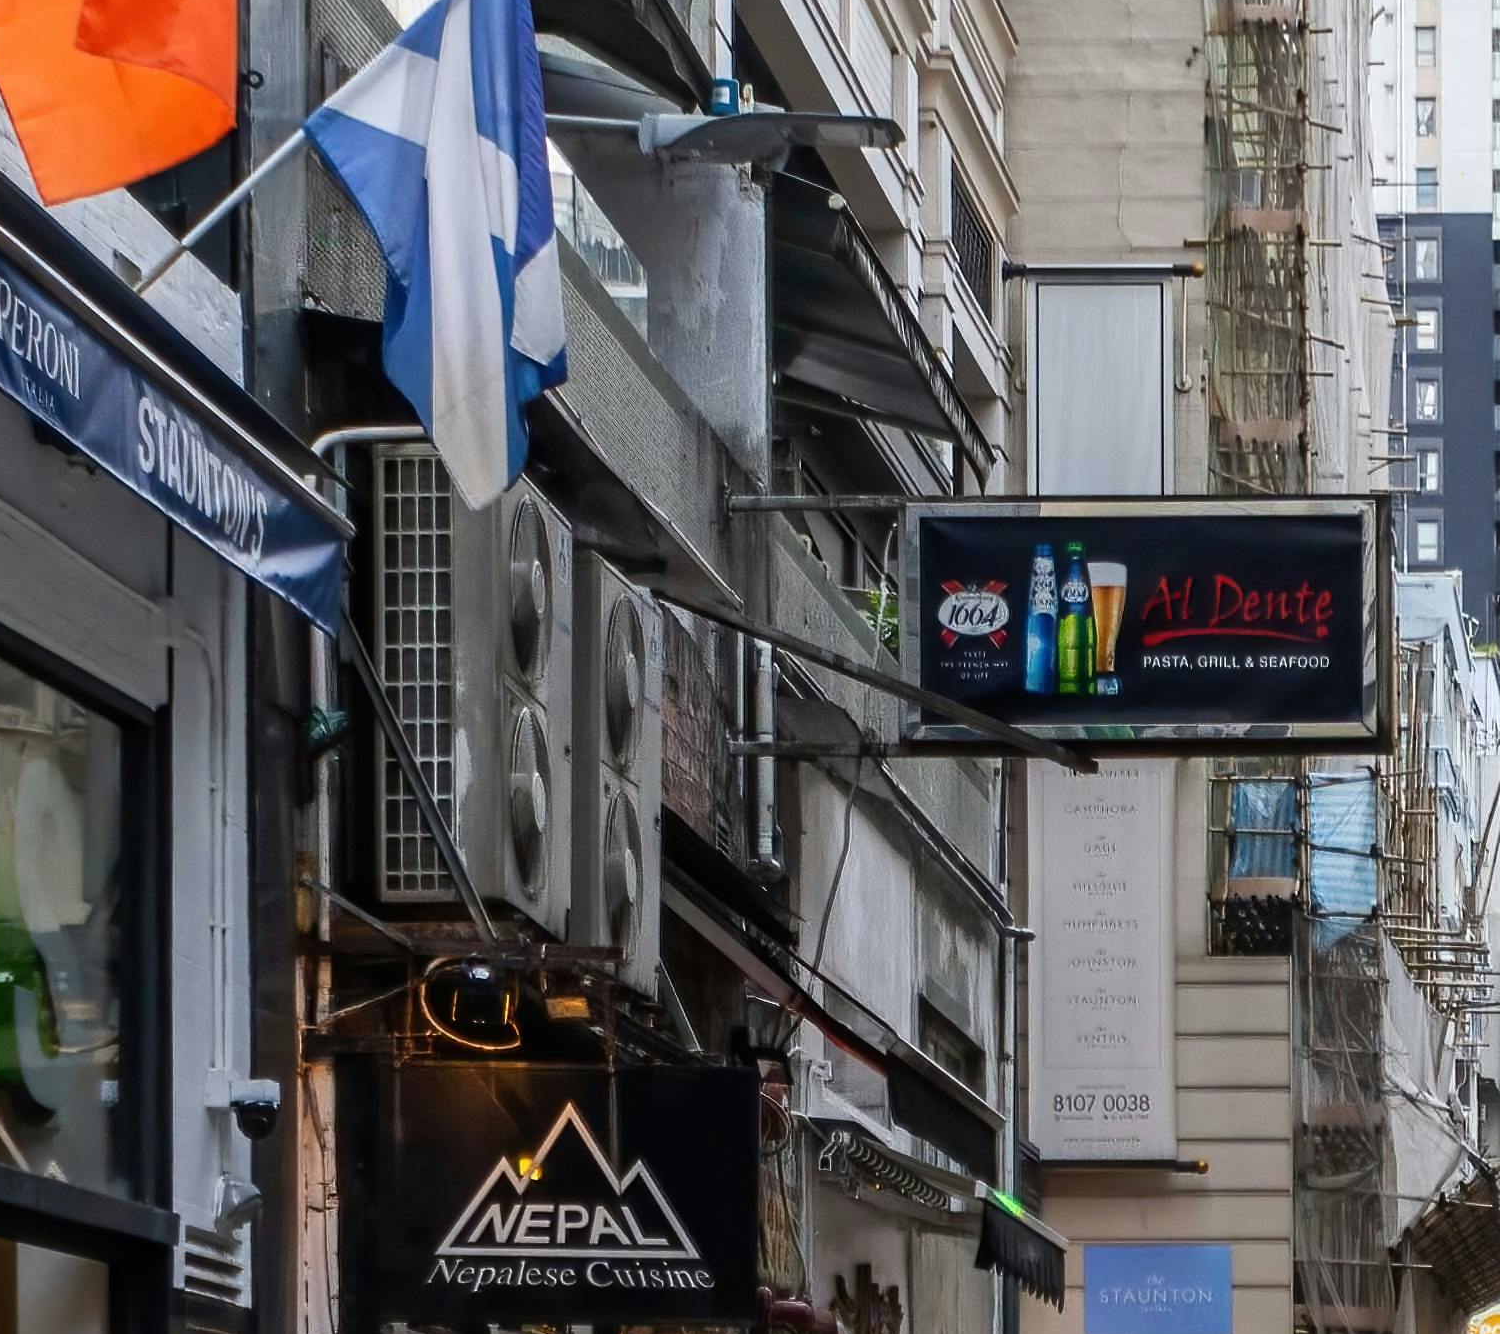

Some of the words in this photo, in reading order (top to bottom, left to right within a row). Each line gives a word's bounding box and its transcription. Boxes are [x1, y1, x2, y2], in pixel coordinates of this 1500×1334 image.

[137, 396, 269, 561] STAUNTON'S
[949, 602, 1000, 628] 1664
[1140, 576, 1194, 621] Al
[1208, 573, 1334, 628] Dente
[1143, 655, 1193, 670] PASTA,
[1198, 655, 1241, 668] GRILL
[1244, 655, 1255, 668] &
[1259, 655, 1331, 668] SEAFOOD
[1053, 1093, 1096, 1113] 8107
[1103, 1093, 1150, 1113] 0038
[467, 1203, 671, 1247] NEPAL
[426, 1259, 577, 1293] Nepalese
[586, 1261, 716, 1289] Cuisine
[1099, 1288, 1213, 1305] STAUNTON
